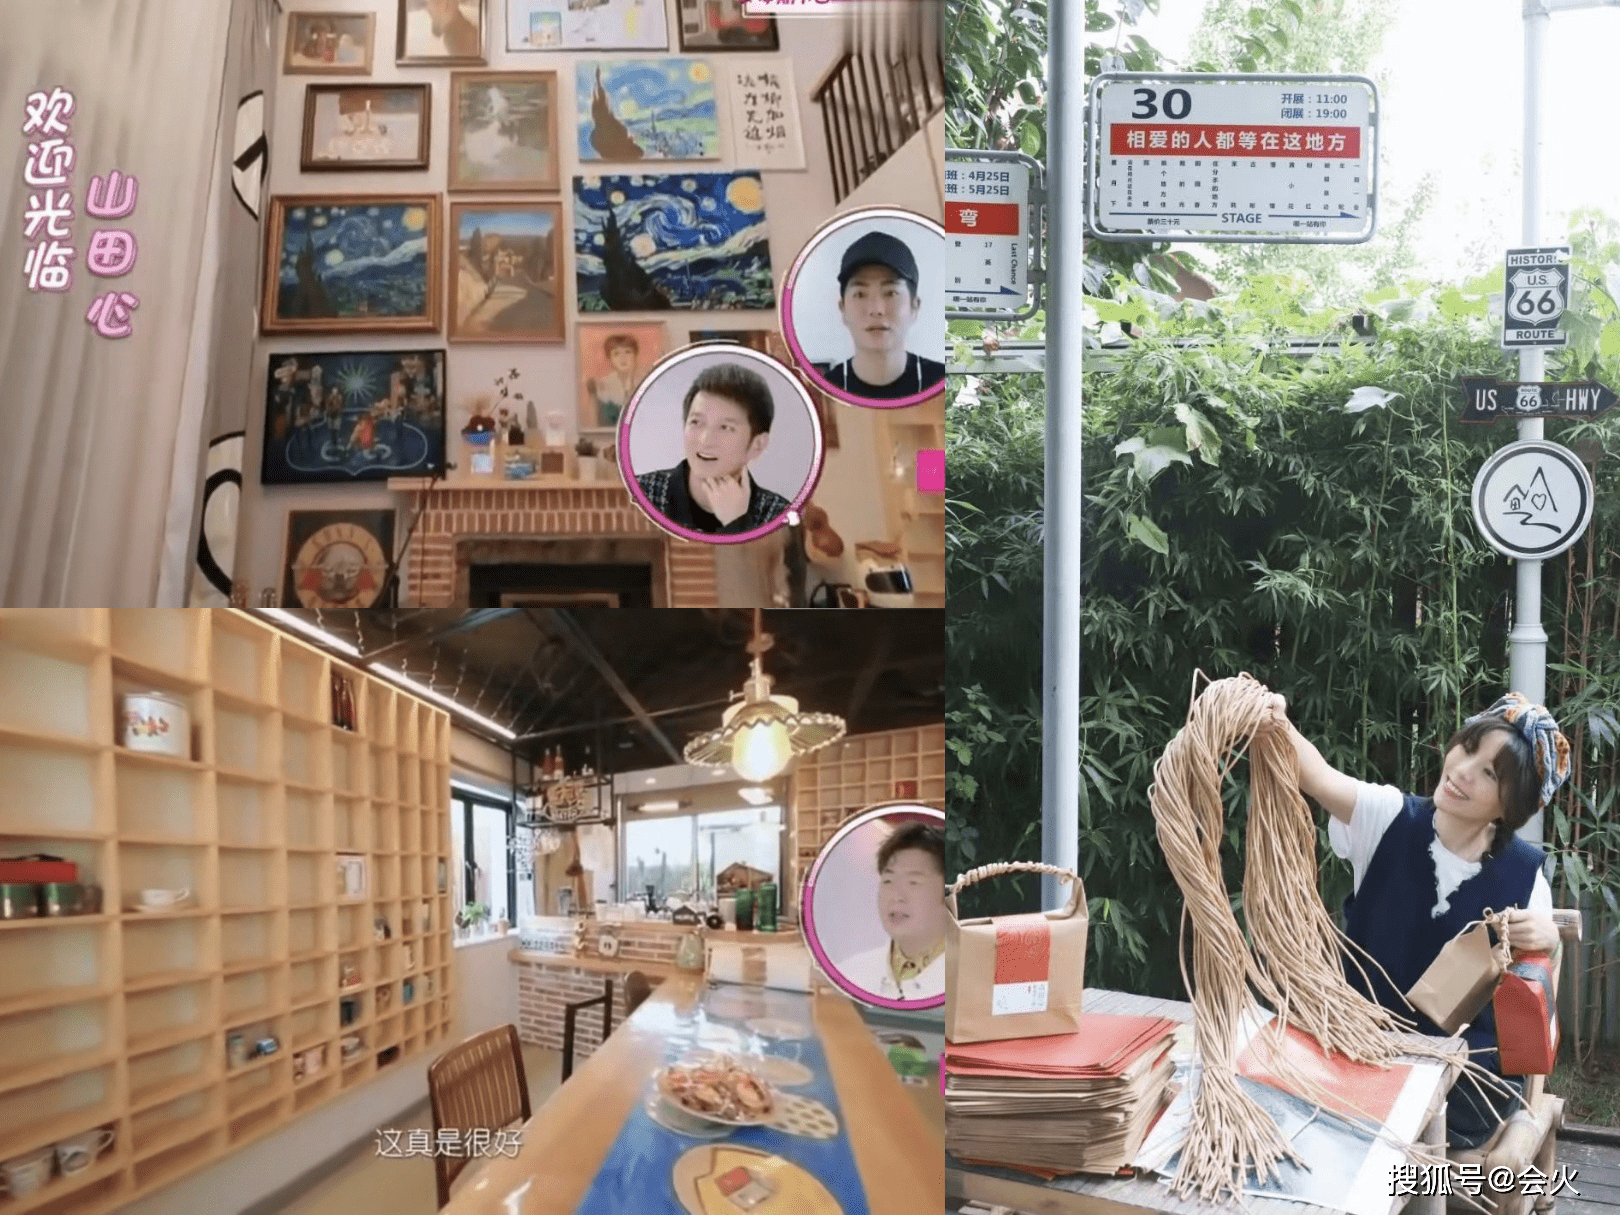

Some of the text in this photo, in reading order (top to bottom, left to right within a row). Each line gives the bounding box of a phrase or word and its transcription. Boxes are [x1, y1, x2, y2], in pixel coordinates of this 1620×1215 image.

[1131, 88, 1192, 119] 30
[1127, 130, 1347, 151] 相爱的人都等在这地方
[945, 170, 1010, 182] 班：4月25日
[945, 183, 1010, 195] 班：5月25日
[959, 209, 979, 227] 弯
[1221, 213, 1263, 224] STAGE
[1527, 275, 1549, 285] U.S.
[1516, 290, 1556, 316] 66
[1516, 330, 1555, 339] ROUTE
[1476, 388, 1601, 411] US HWY
[1520, 395, 1538, 408] 66
